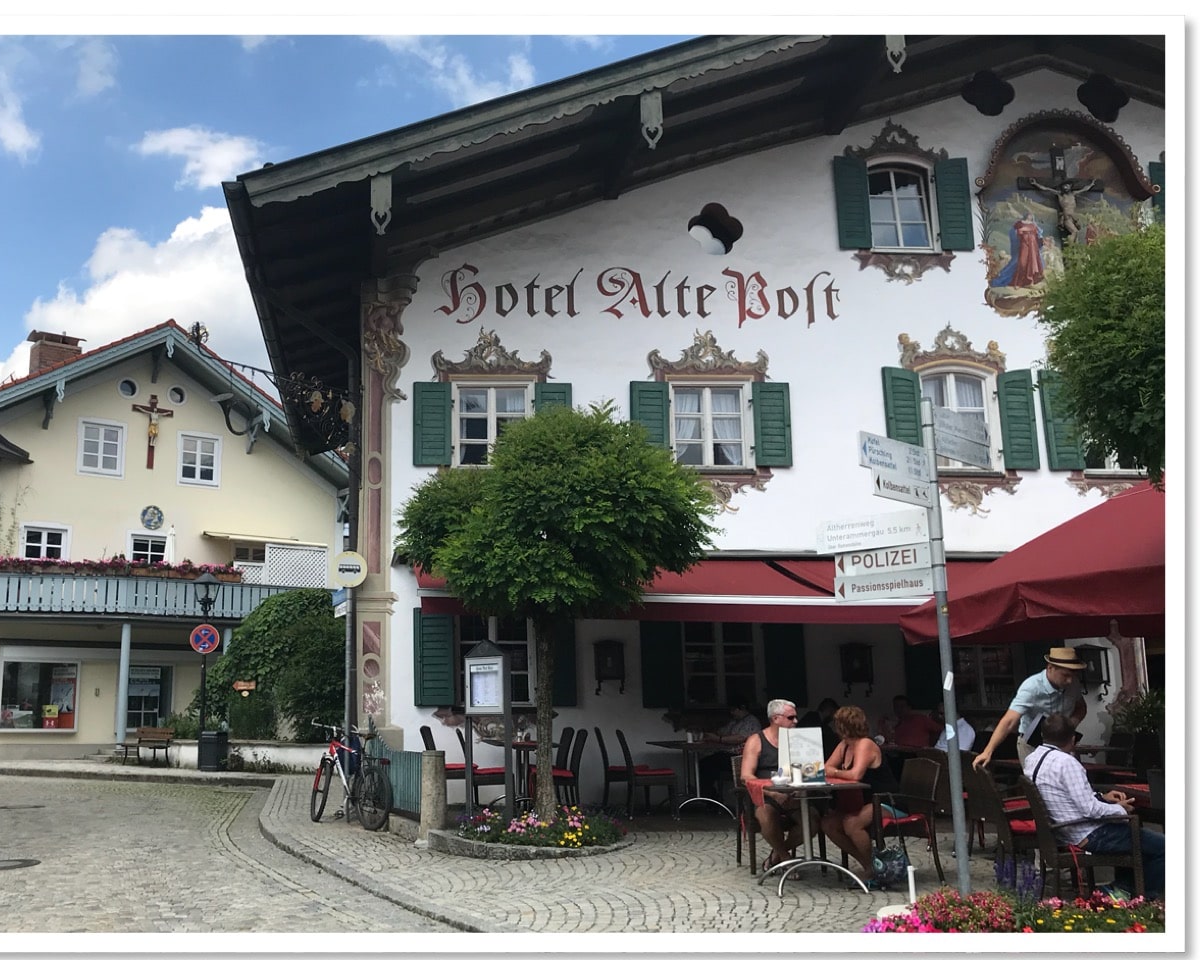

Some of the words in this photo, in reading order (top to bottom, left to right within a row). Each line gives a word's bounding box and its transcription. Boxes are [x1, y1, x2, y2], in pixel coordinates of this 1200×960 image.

[434, 262, 584, 324] Hotel
[596, 265, 717, 319] Alte
[827, 520, 875, 531] Altherrenweg
[827, 530, 885, 542] Unterammergau
[899, 525, 911, 533] km
[851, 548, 918, 569] POLIZEI
[851, 579, 924, 594] Passionsspielhaus
